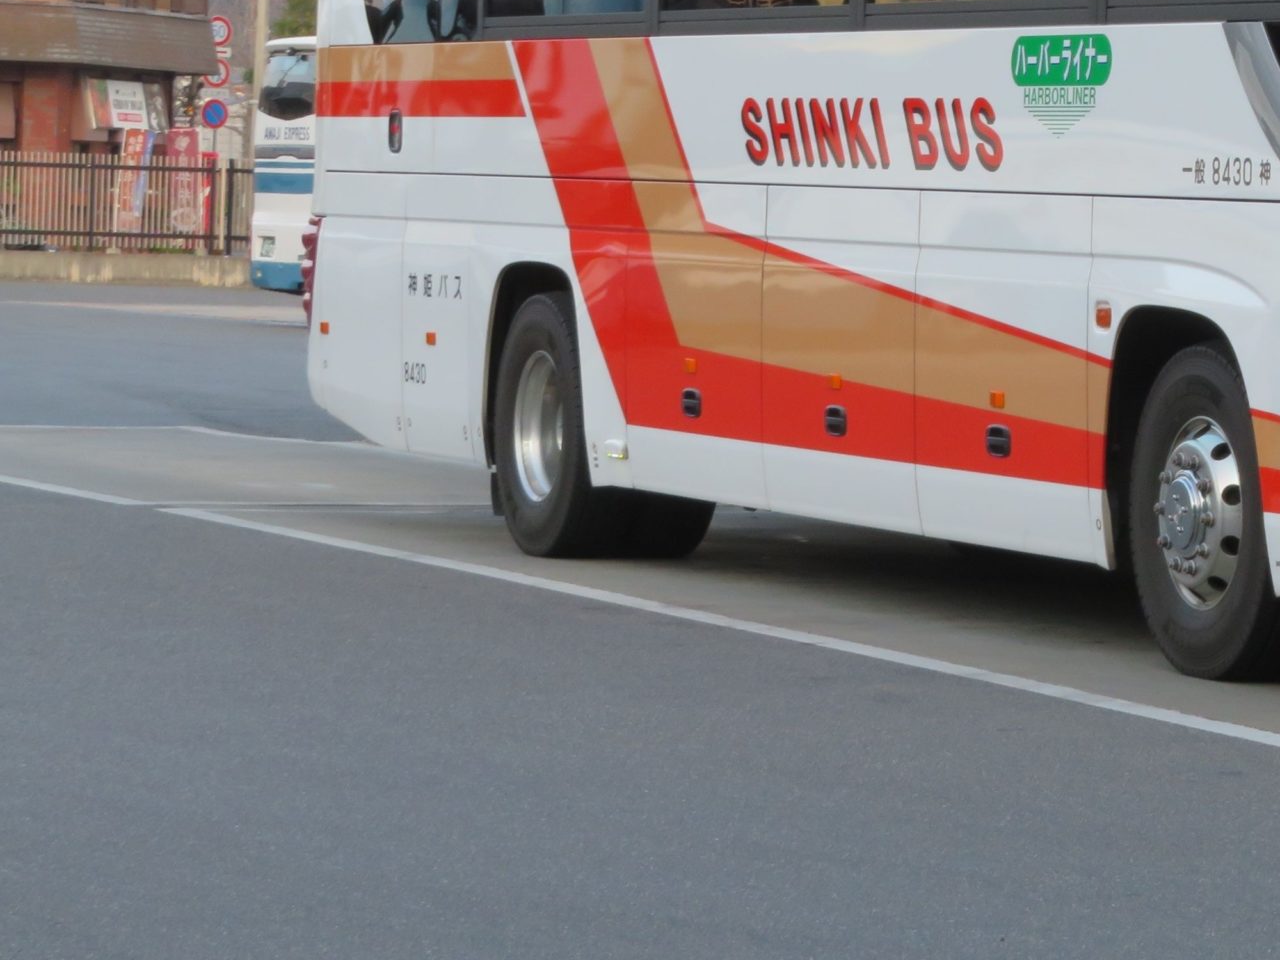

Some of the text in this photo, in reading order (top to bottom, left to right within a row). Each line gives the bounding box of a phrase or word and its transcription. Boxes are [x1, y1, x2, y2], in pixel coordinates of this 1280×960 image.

[1015, 37, 1109, 81] ハーバーライナー
[1023, 87, 1096, 105] HARBORLINER
[284, 126, 310, 141] EXPRESS
[741, 96, 1004, 172] SHINKI BUS
[1182, 156, 1272, 187] 一般 8430 神
[404, 361, 427, 385] 8430
